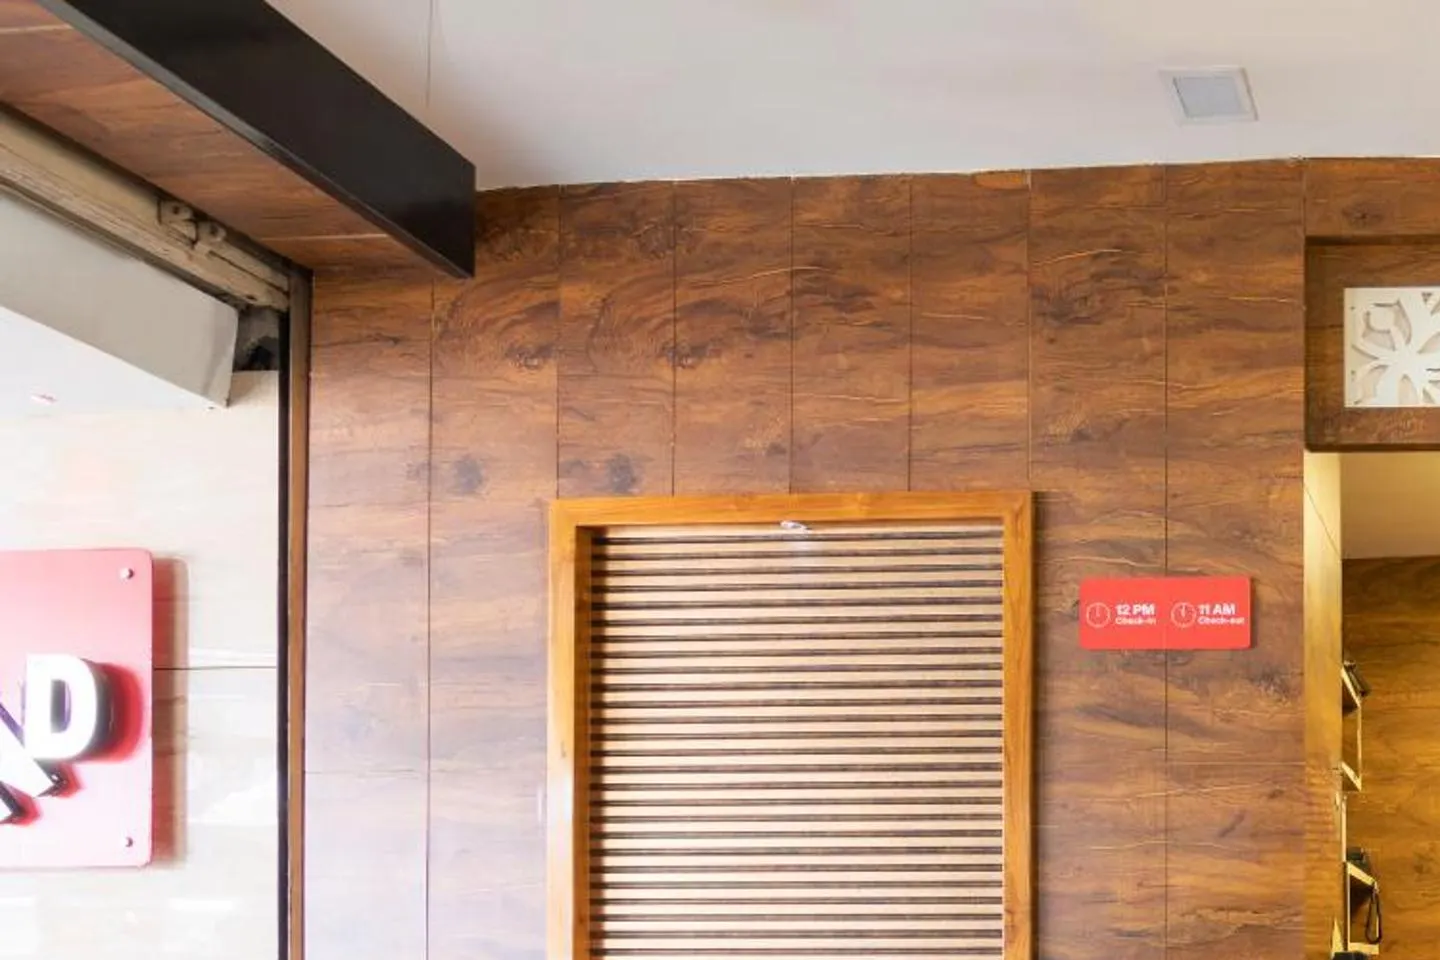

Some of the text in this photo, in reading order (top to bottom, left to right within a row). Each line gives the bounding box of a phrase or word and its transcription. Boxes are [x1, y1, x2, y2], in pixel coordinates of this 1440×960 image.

[1115, 603, 1155, 616] 12 PM
[1199, 602, 1236, 615] 11 AM
[1115, 616, 1157, 626] Check-in
